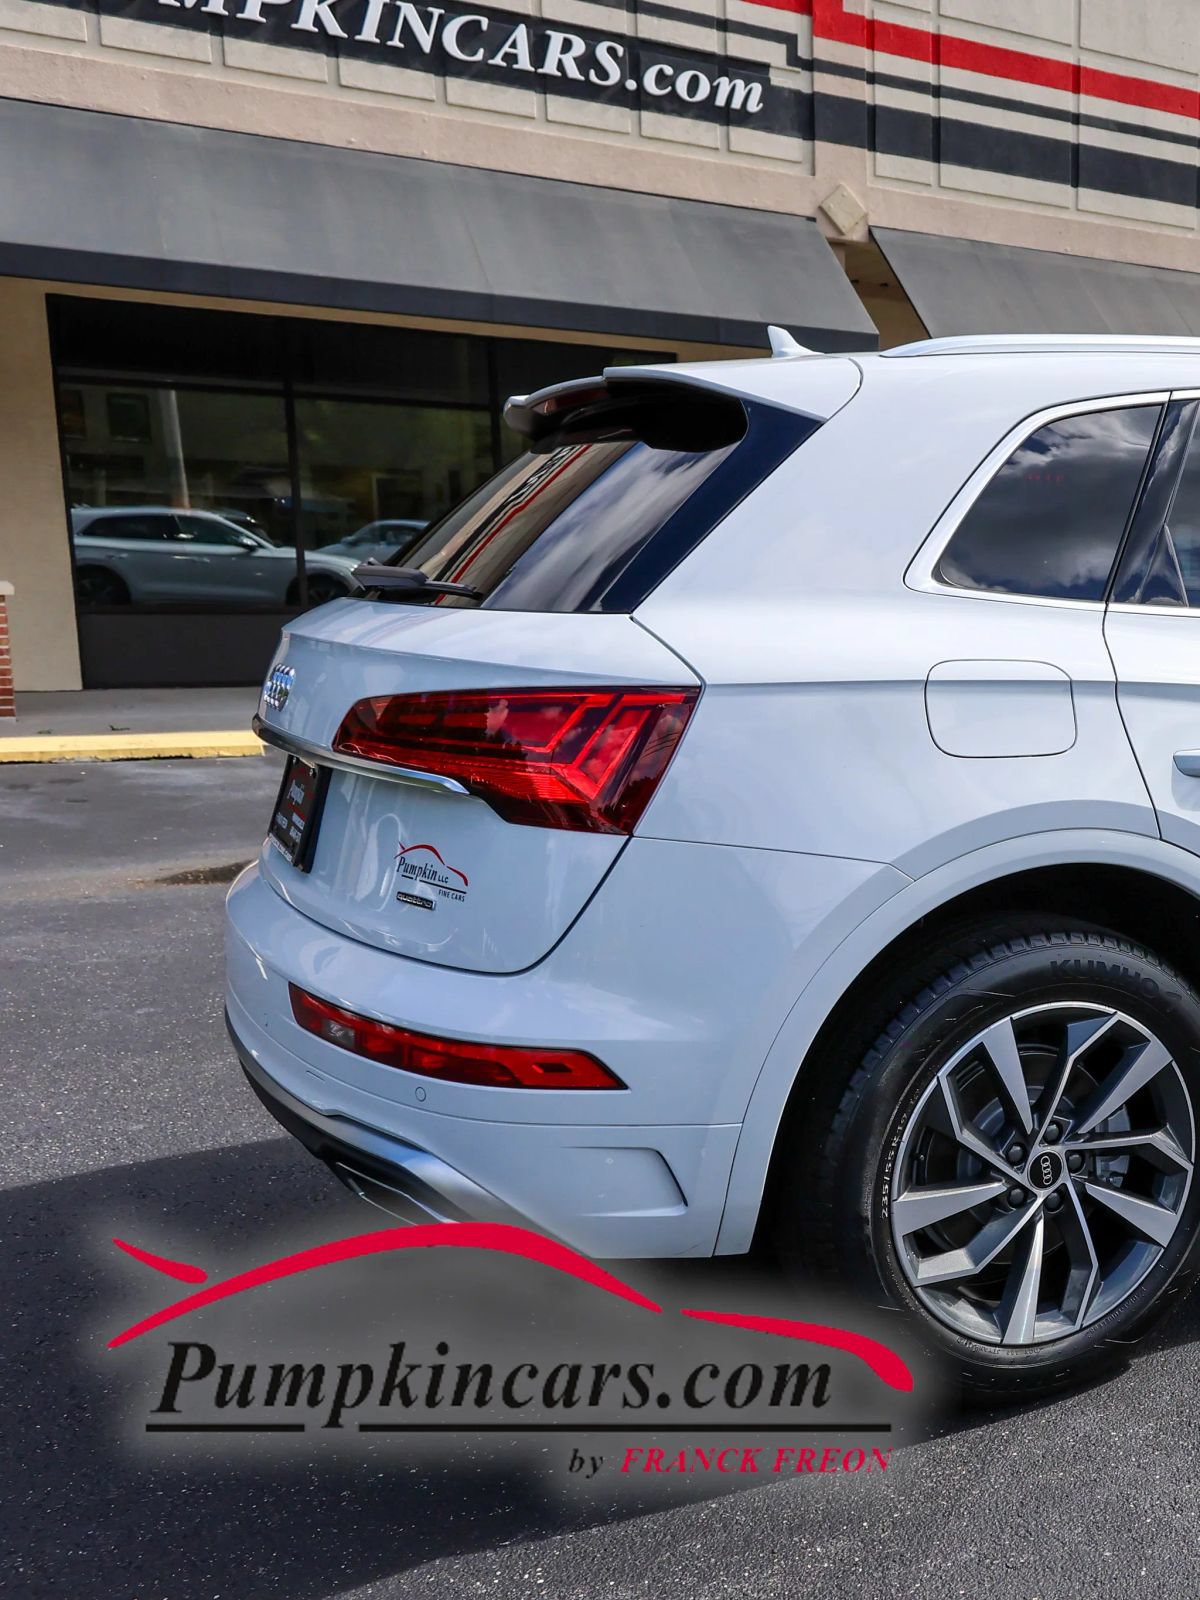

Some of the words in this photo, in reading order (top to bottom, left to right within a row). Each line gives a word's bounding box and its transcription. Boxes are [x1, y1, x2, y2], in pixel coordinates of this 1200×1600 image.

[396, 856, 438, 881] Pumpkin
[438, 889, 451, 899] FINE
[450, 892, 465, 903] CARS
